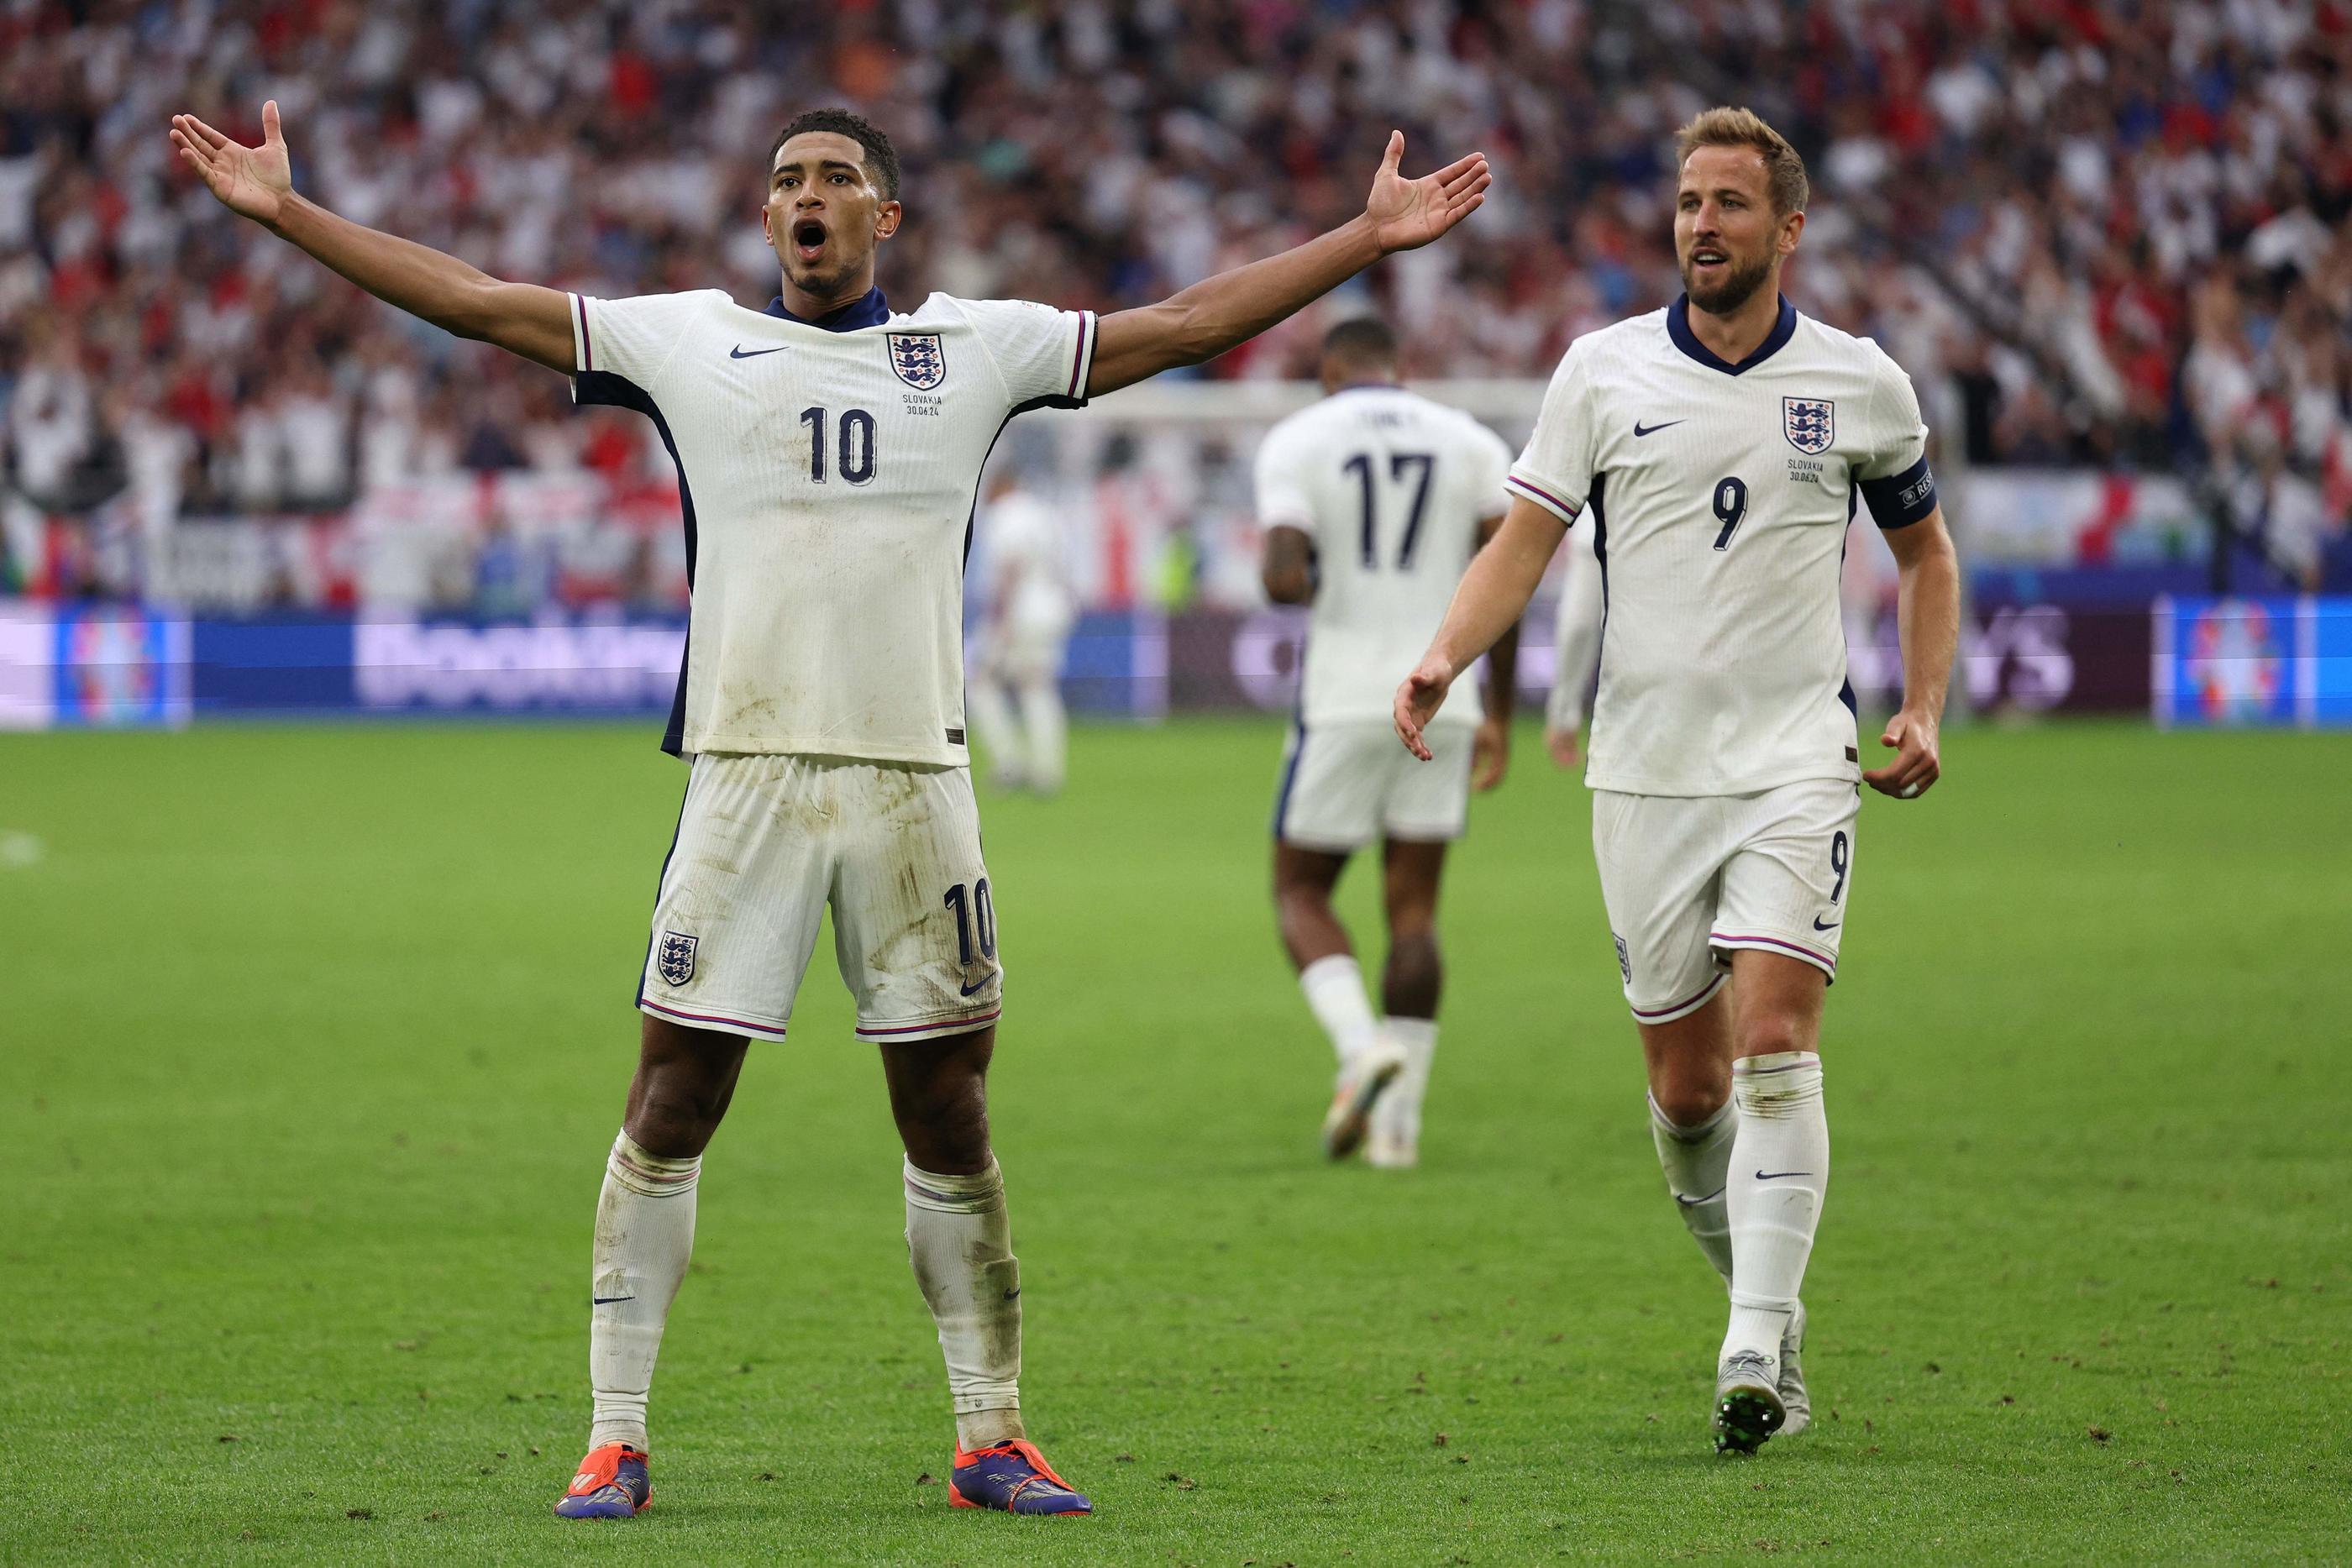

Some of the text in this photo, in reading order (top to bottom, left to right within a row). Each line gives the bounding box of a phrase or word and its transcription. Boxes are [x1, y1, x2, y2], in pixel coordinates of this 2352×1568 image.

[902, 394, 942, 405] SLOVAKIA
[907, 406, 939, 416] 30.06.24
[801, 406, 877, 487] 10
[1788, 459, 1824, 472] SLOVAKIA
[1790, 471, 1819, 483] 30.06.24
[1342, 452, 1435, 570] 17
[1713, 476, 1748, 551] 9
[1830, 830, 1847, 906] 9
[944, 878, 995, 965] 10
